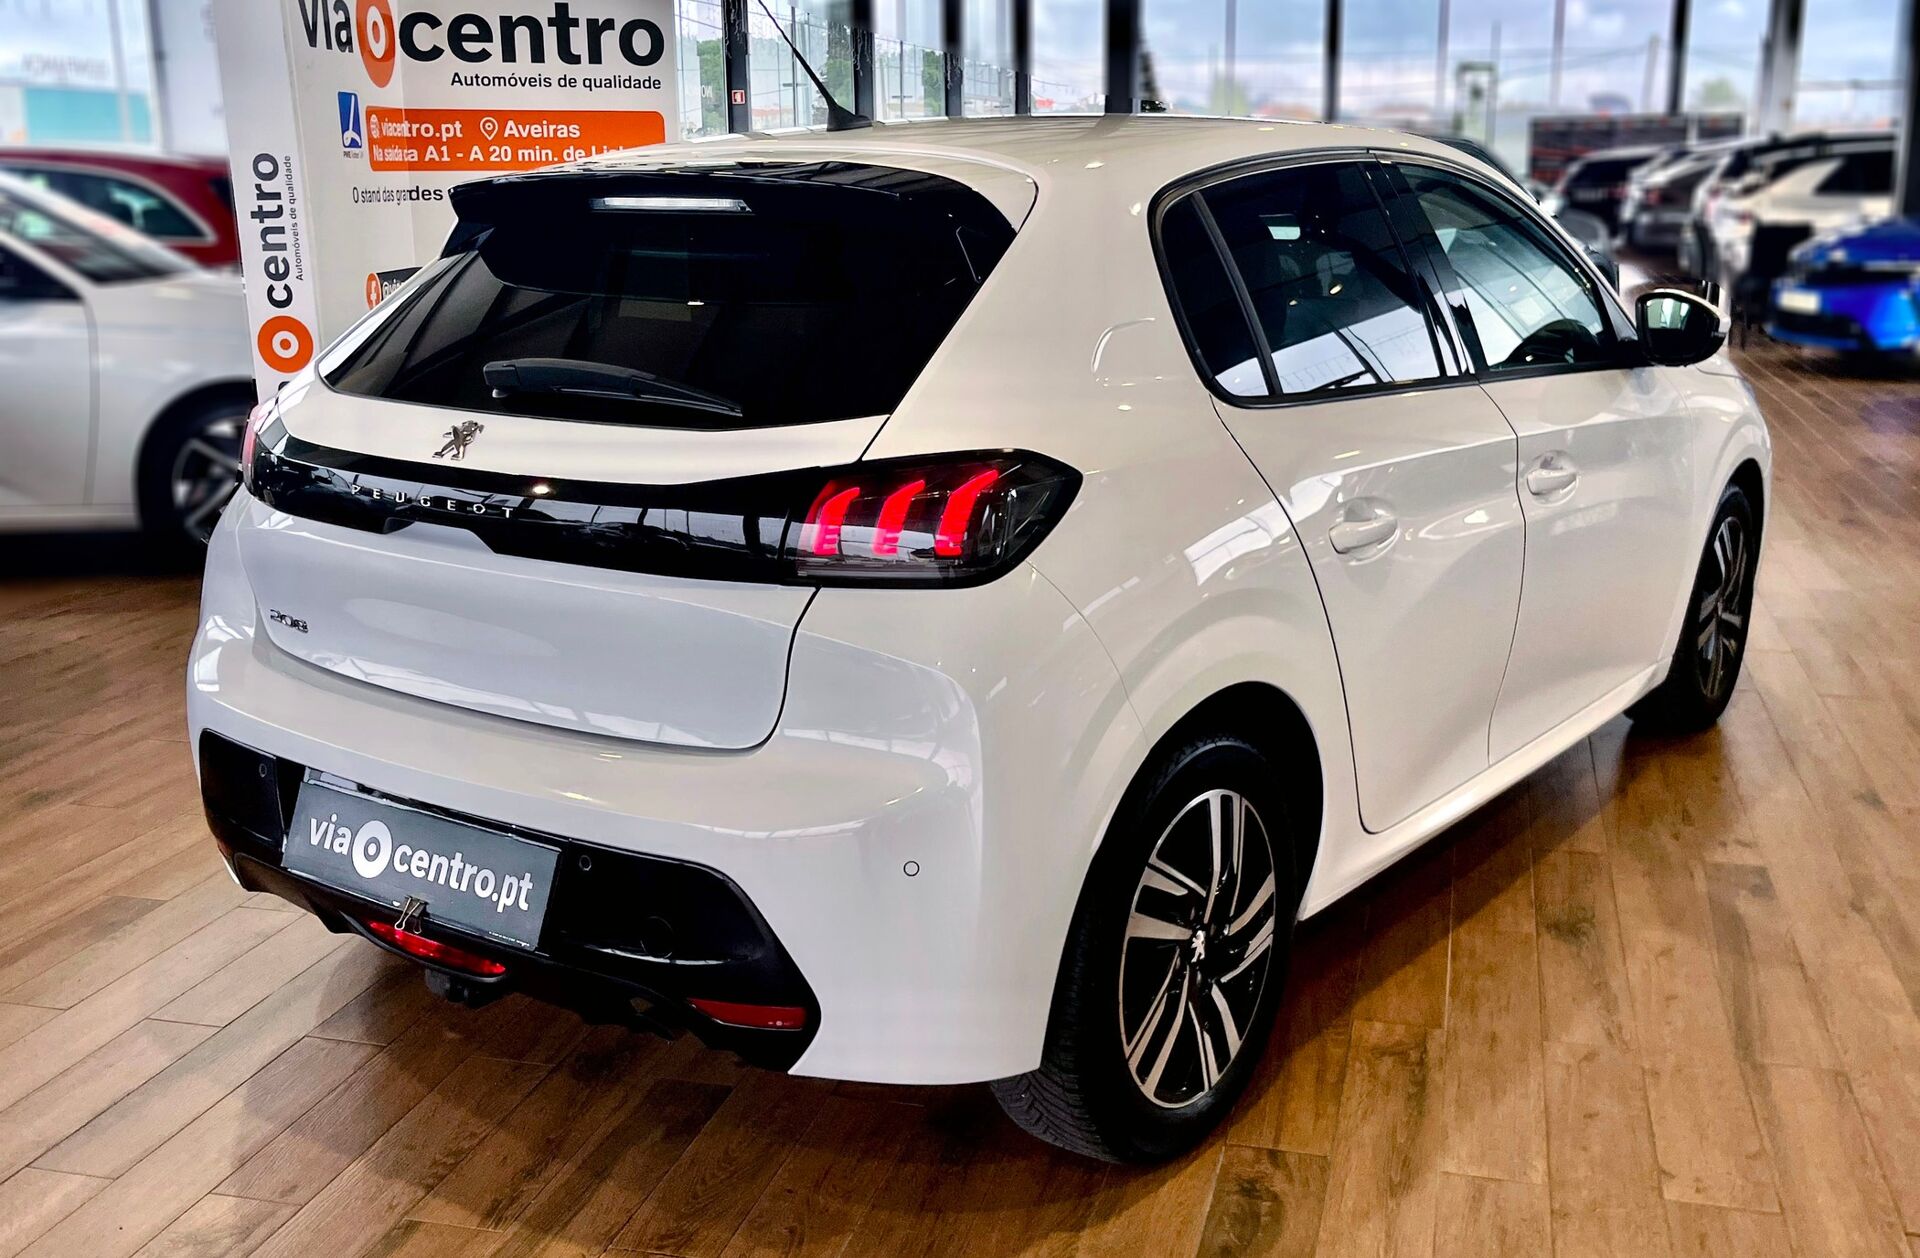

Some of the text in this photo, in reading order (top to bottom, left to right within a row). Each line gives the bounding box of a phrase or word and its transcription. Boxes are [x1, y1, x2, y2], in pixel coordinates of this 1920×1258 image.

[399, 2, 665, 67] centro
[450, 72, 662, 91] Automóveis de qualidade
[504, 120, 581, 138] Aveiras
[424, 145, 451, 162] A1
[469, 145, 485, 162] A
[489, 146, 512, 162] 20
[518, 145, 558, 162] min.
[563, 146, 586, 162] de
[352, 185, 444, 206] O stand das grandes
[250, 152, 294, 309] centro
[283, 155, 304, 281] Automóveis de qualidade
[351, 484, 514, 519] PEUGEOT
[270, 608, 309, 633] 208
